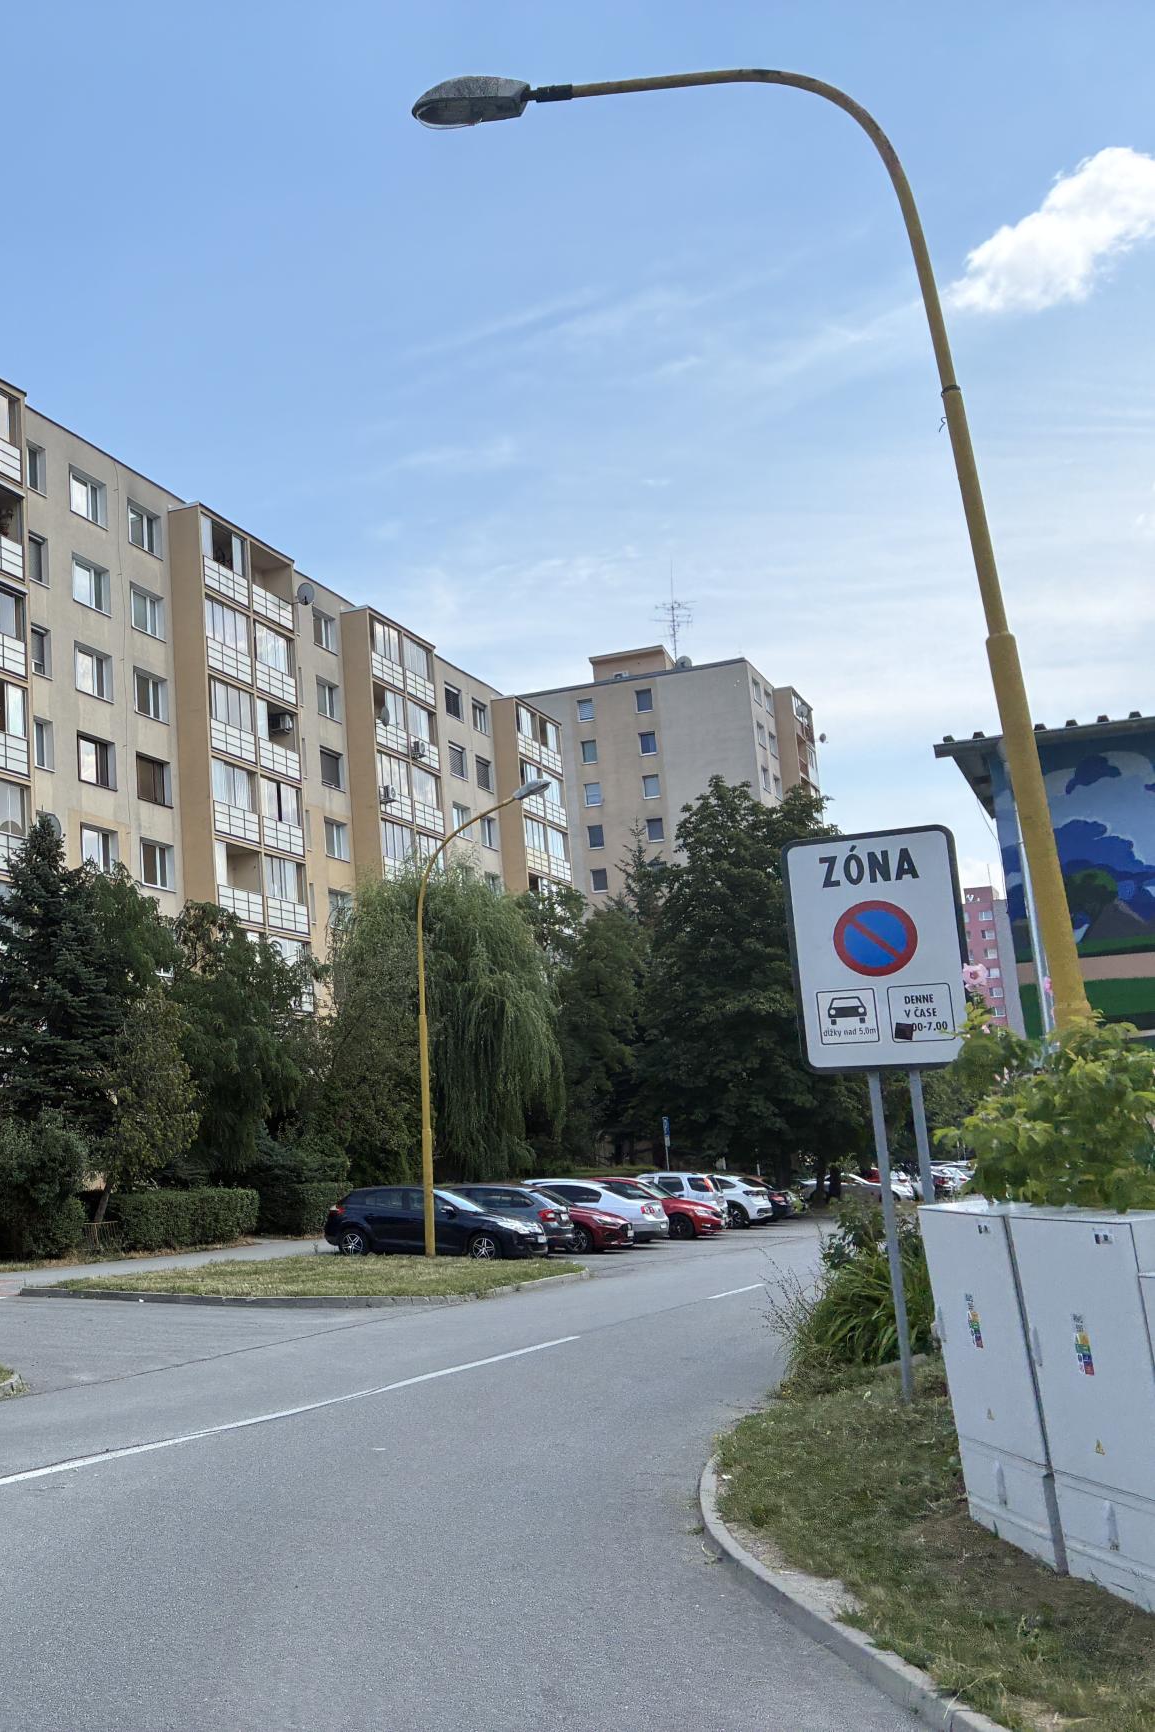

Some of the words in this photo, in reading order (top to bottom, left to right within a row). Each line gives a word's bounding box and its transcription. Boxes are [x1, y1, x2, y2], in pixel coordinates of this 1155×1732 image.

[819, 845, 919, 888] ZÓNA
[904, 994, 934, 1004] DENNE
[904, 1009, 911, 1018] V
[914, 1006, 937, 1017] ČASE
[911, 1021, 948, 1032] 00-7.00
